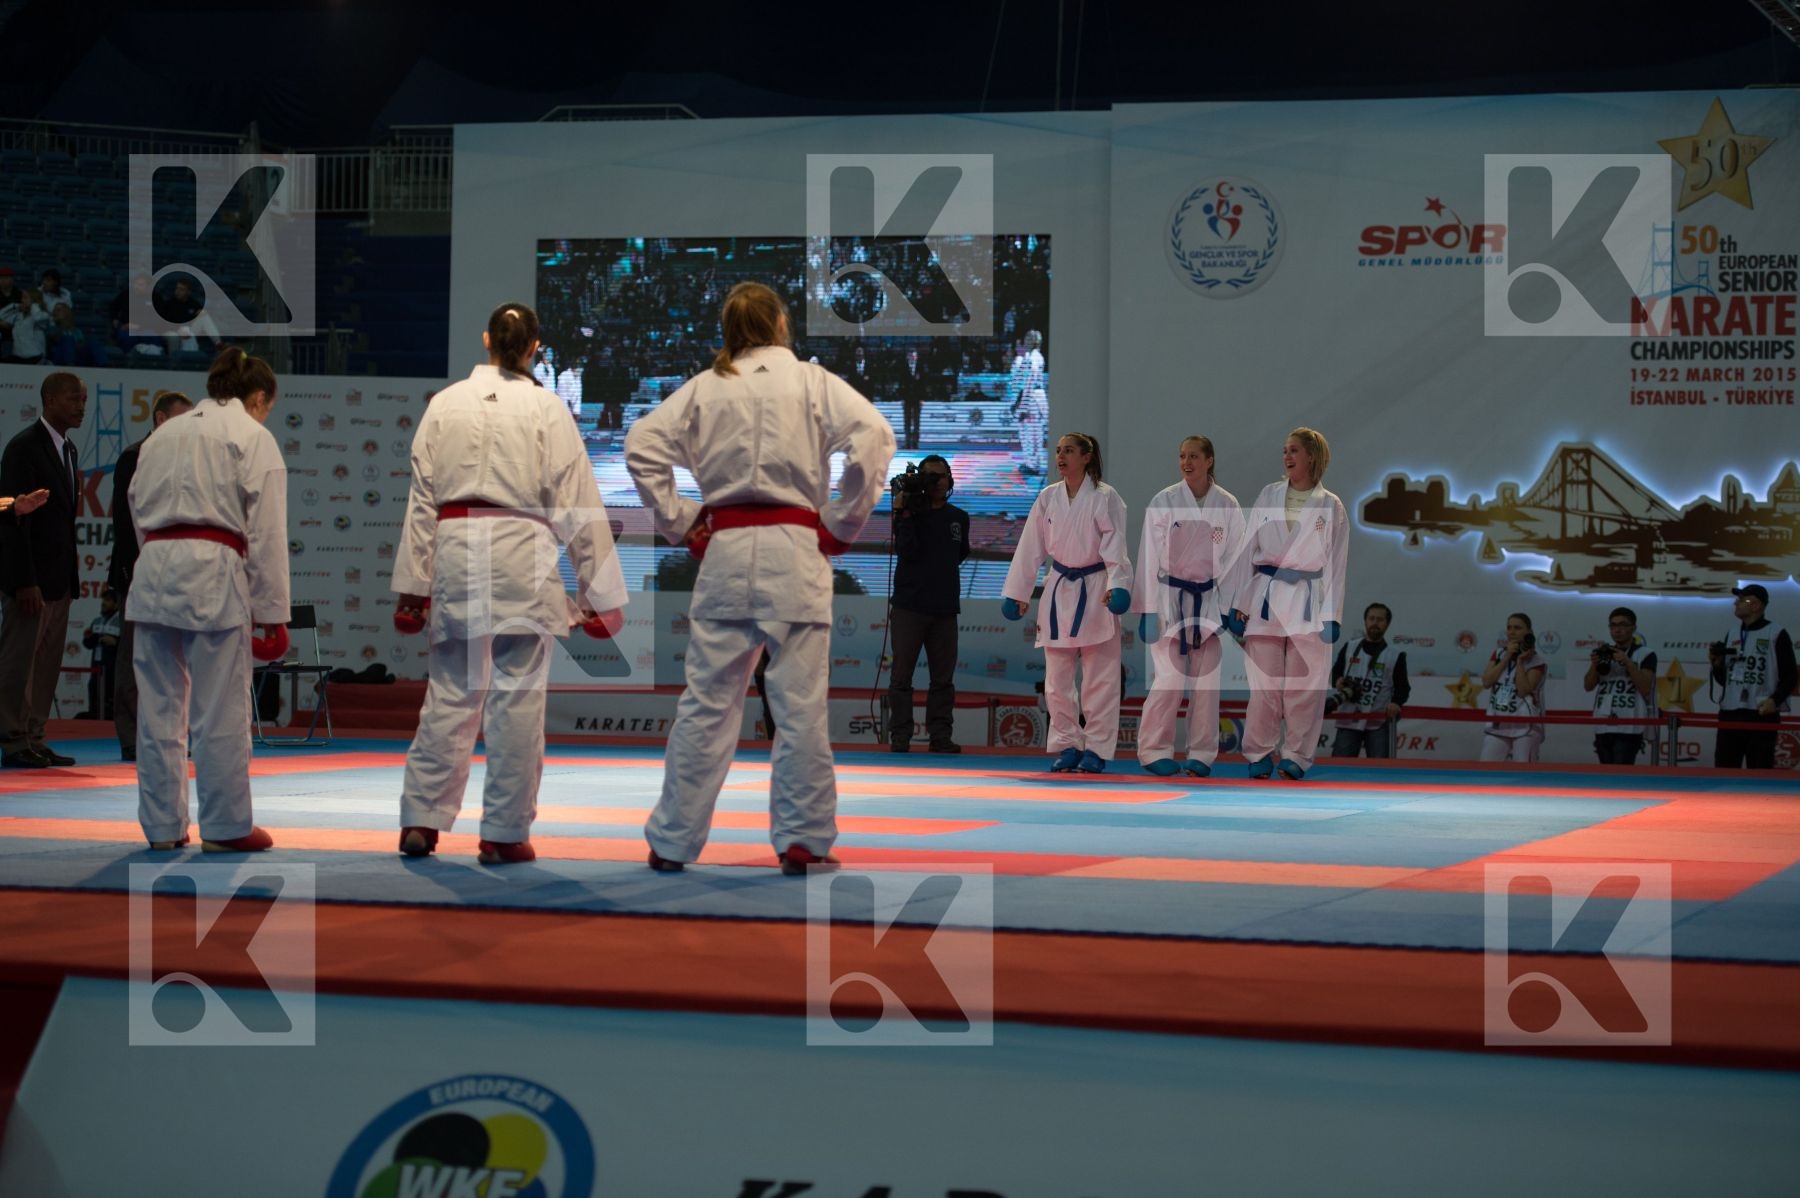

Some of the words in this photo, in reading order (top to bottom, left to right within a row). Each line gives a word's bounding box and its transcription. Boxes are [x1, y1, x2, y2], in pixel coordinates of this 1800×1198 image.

[1358, 223, 1508, 256] SPOR
[1358, 258, 1405, 267] GENEL
[1719, 254, 1798, 270] EUROPEAN
[1718, 270, 1798, 293] SENIOR
[1630, 295, 1797, 336] KARATE
[1630, 340, 1795, 361] CHAMPIONSHIPS
[1630, 367, 1679, 382] 19-22
[1685, 367, 1745, 382] MARCH
[1753, 367, 1797, 382] 2015
[1630, 386, 1707, 405] İSTANBUL
[1725, 386, 1795, 405] TÜRKİYE
[429, 1078, 555, 1112] EUROPEAN
[398, 1163, 525, 1198] WKF
